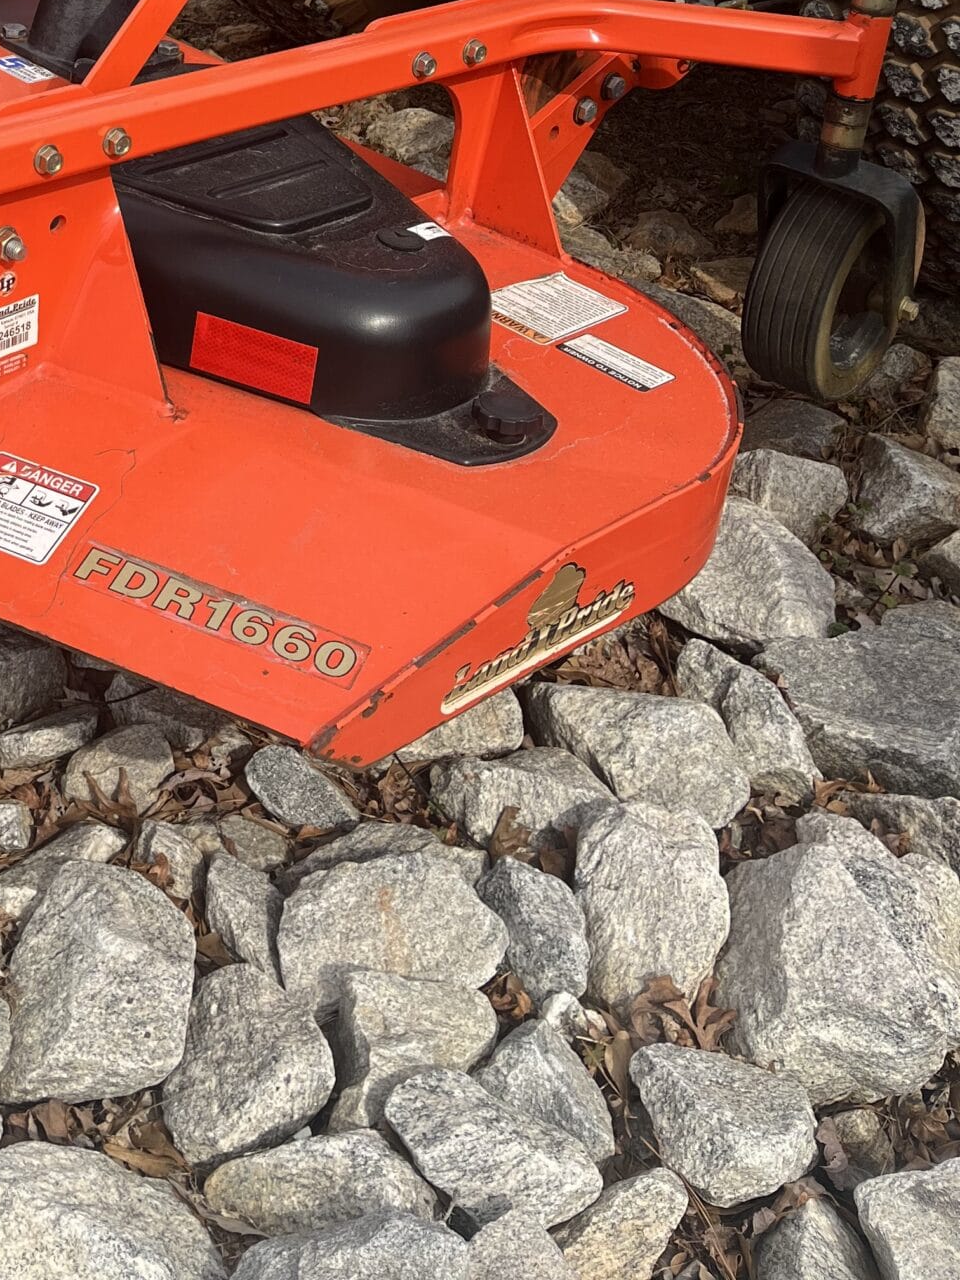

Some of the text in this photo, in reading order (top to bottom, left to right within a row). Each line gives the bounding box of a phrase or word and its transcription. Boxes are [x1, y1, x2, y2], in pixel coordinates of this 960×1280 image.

[12, 298, 36, 312] Pride
[491, 310, 529, 334] WARN
[563, 347, 642, 389] NOTICE TO OWNER
[20, 465, 84, 497] DANGER
[1, 501, 25, 516] BLADES
[28, 509, 46, 524] KEEP
[44, 515, 65, 529] AWAY
[72, 546, 358, 678] FDR1660
[443, 579, 635, 705] Land Pride
